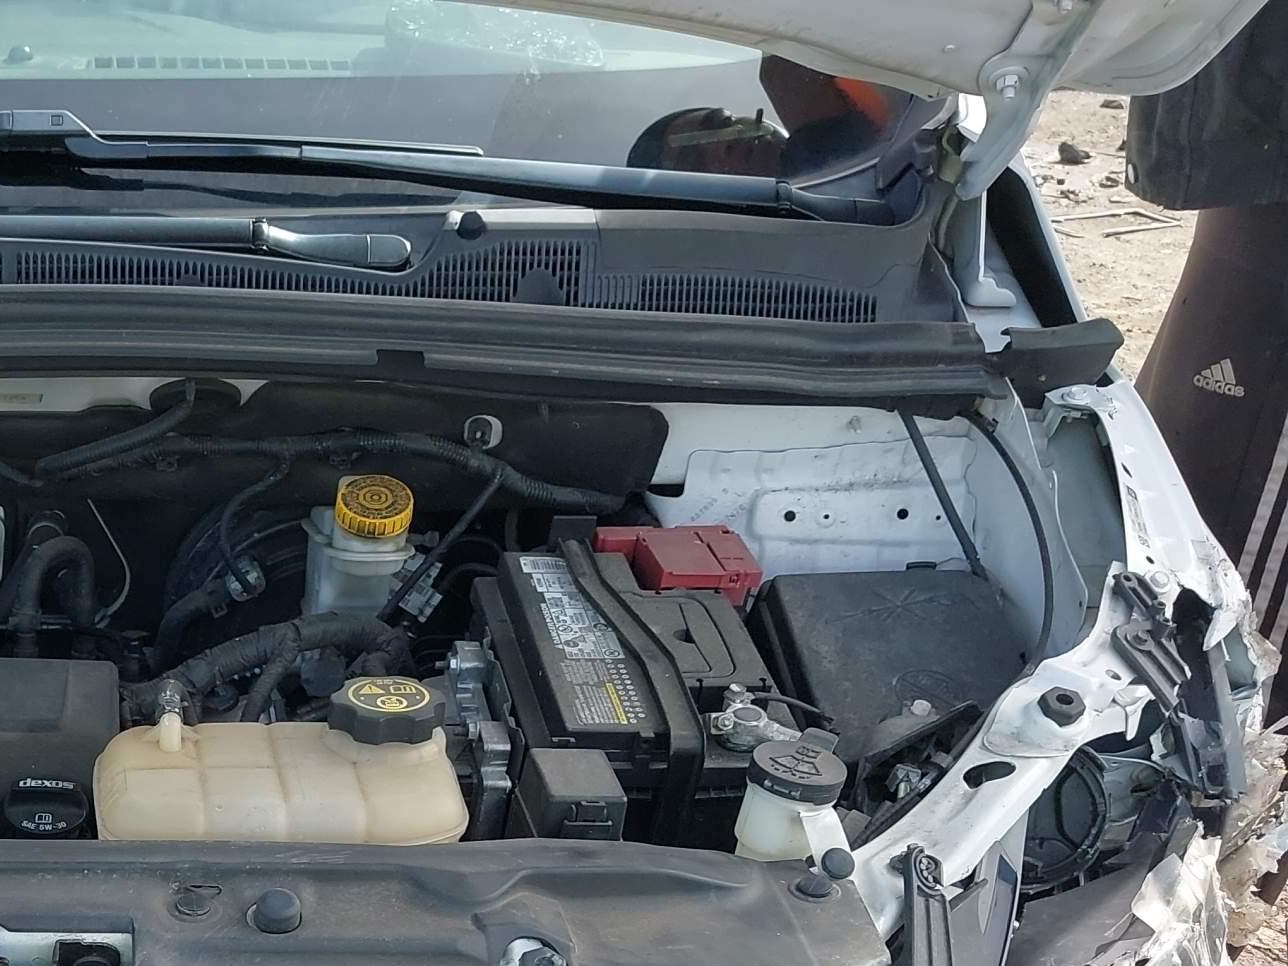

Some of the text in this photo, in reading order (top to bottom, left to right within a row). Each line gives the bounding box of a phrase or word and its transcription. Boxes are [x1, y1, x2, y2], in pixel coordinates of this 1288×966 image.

[1193, 374, 1245, 397] adidas
[18, 778, 76, 789] dexos
[21, 820, 67, 830] SAE 5W-30
